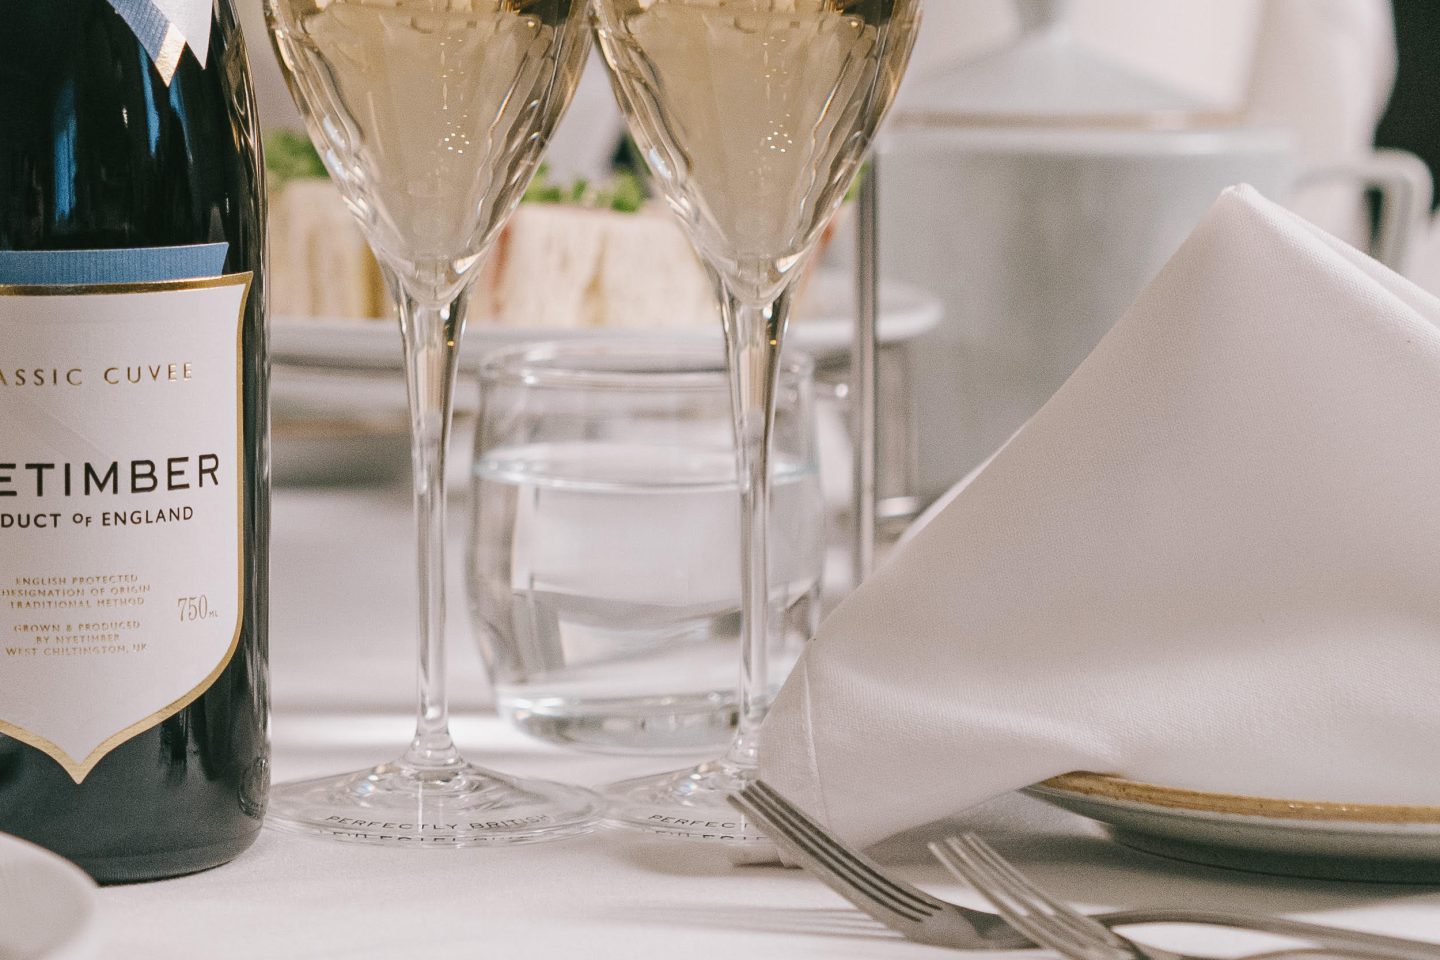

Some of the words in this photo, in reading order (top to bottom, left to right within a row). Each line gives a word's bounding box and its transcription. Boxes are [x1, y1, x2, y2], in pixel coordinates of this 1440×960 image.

[103, 362, 193, 385] CUVEE
[73, 512, 92, 527] OF
[102, 506, 194, 526] ENGLAND
[16, 576, 67, 586] ENGLISH
[72, 574, 138, 584] PROTECTED
[1, 588, 85, 597] DESIGNATION
[90, 587, 106, 596] OF
[110, 584, 151, 595] ORIGIN
[10, 600, 92, 609] TRADITIONAL
[97, 598, 144, 608] METHOD
[13, 623, 61, 632] GROWN
[78, 621, 141, 631] PRODUCED
[36, 635, 49, 644] BY
[56, 634, 120, 644] NYETIMBER
[5, 647, 37, 656] WEST
[325, 815, 458, 830] PERFECTLY
[468, 814, 550, 830] BRITISH
